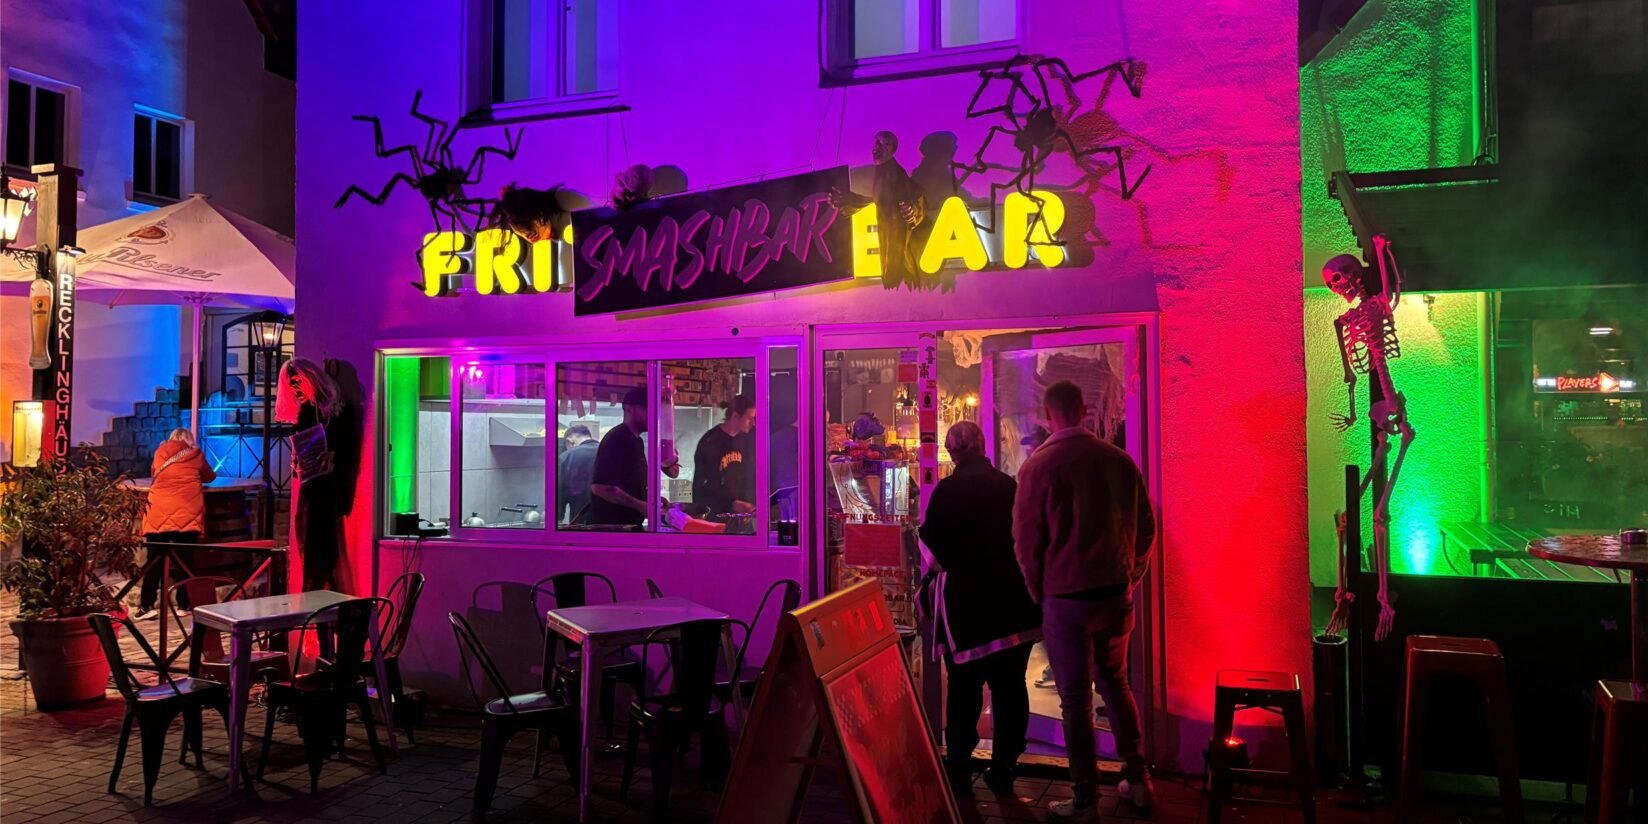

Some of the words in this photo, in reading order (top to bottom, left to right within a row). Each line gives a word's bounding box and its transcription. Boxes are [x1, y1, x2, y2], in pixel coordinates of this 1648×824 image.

[106, 245, 222, 278] Pilsener
[422, 228, 573, 298] FRI
[577, 191, 838, 302] SMASHBAR
[1557, 376, 1598, 390] PLAYERS
